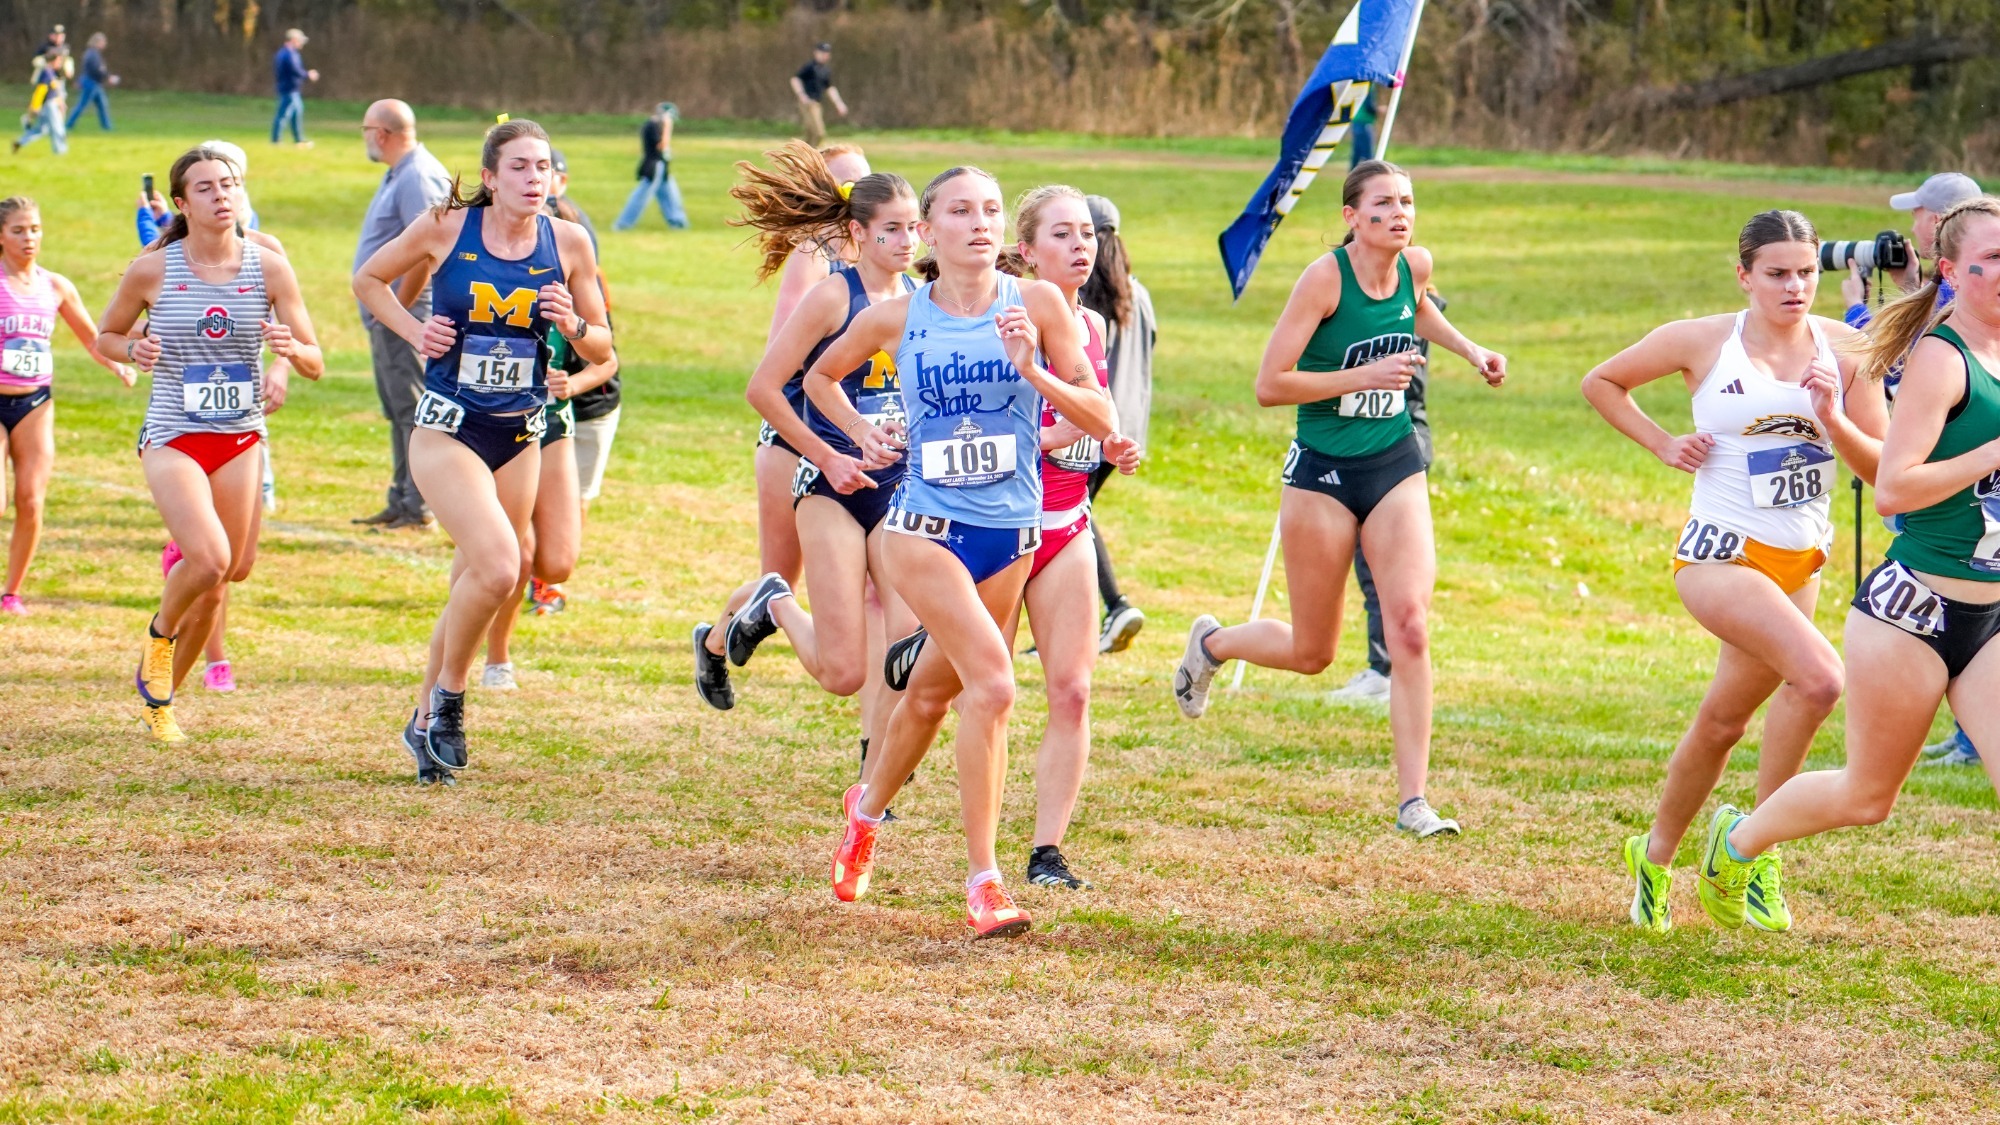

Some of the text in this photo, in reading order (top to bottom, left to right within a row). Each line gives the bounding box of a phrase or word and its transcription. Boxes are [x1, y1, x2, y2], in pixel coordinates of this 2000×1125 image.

[469, 281, 538, 328] M
[13, 354, 40, 373] 251
[475, 359, 520, 386] 154
[198, 386, 240, 410] 208
[918, 388, 1017, 420] State
[1354, 392, 1394, 417] 202
[943, 441, 999, 476] 109
[1770, 468, 1822, 506] 268
[1677, 518, 1739, 560] 268
[1870, 568, 1938, 631] 204
